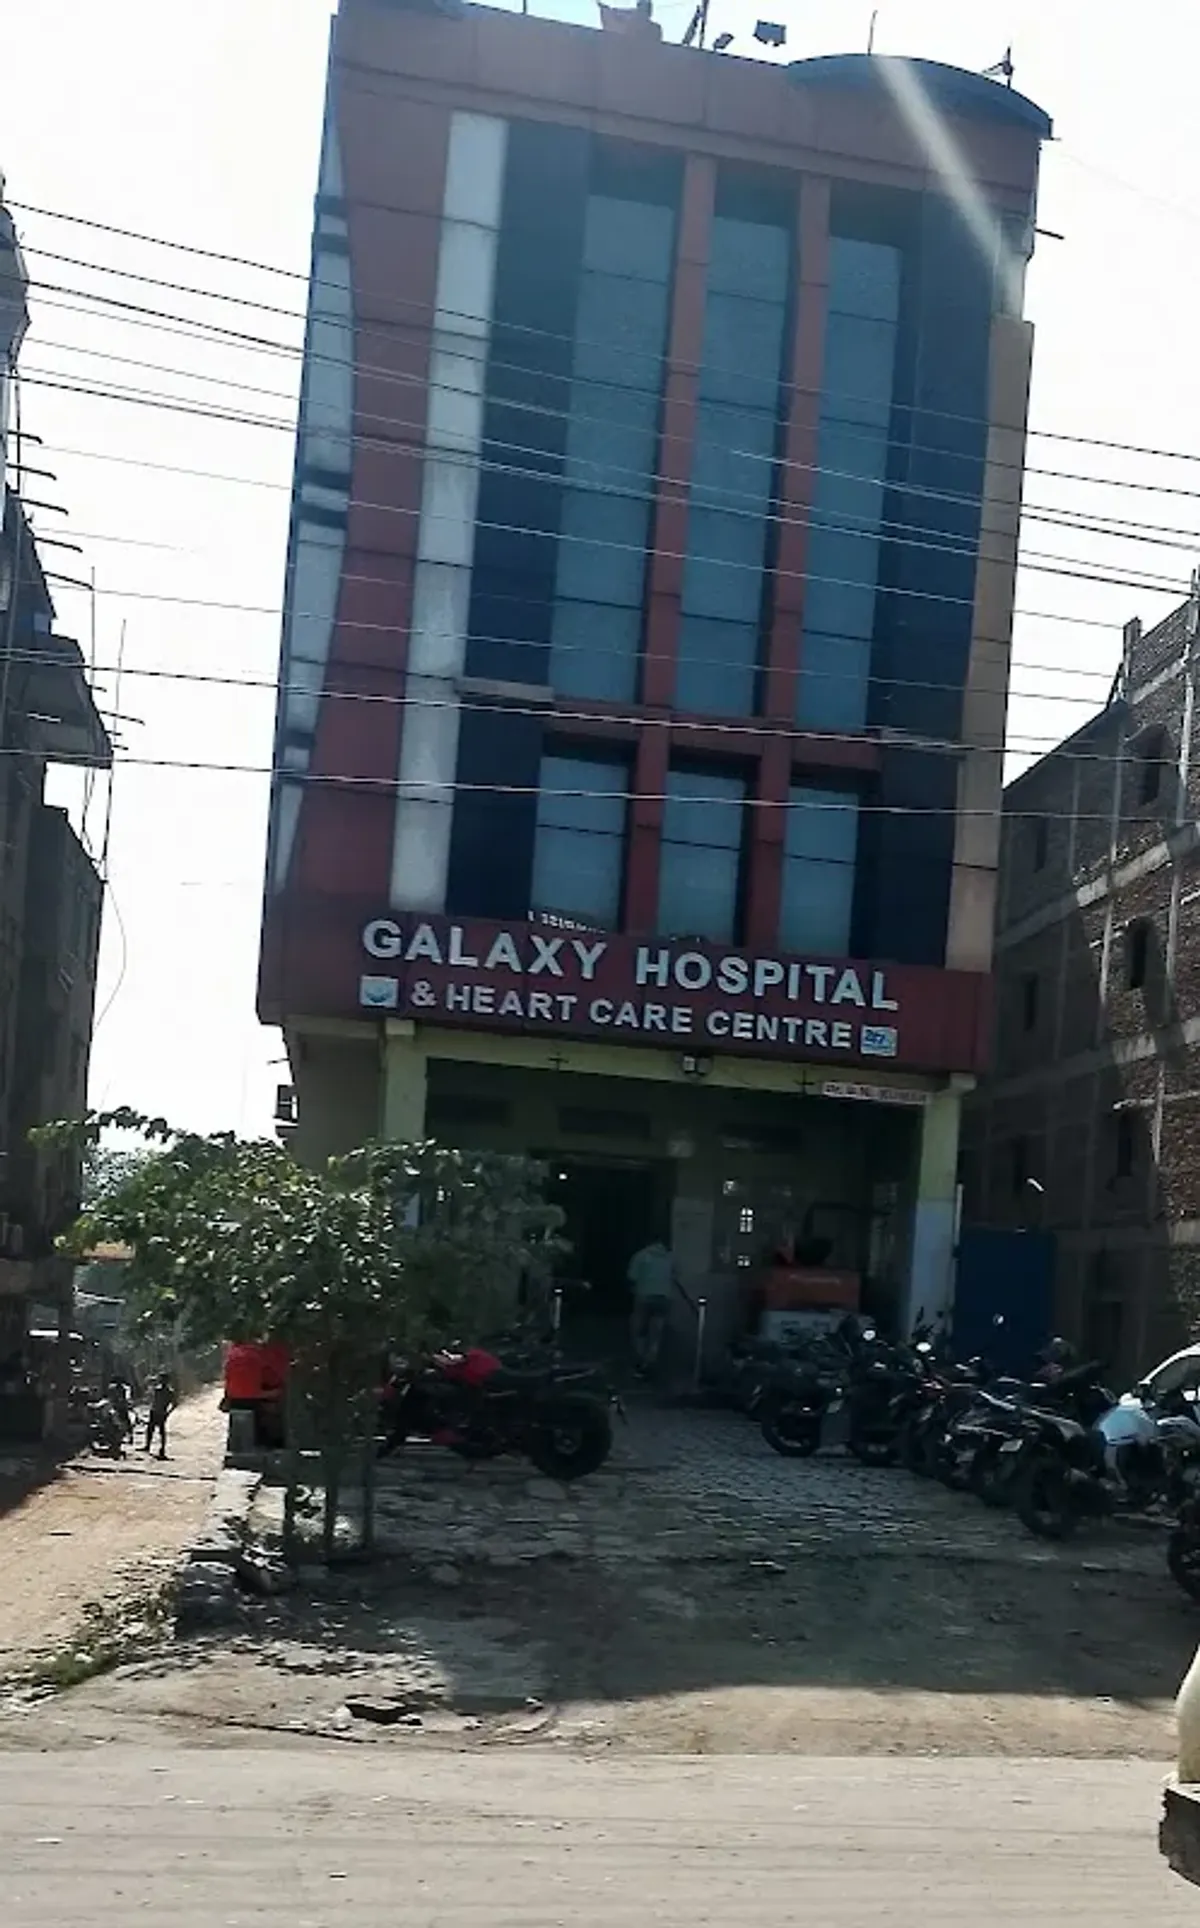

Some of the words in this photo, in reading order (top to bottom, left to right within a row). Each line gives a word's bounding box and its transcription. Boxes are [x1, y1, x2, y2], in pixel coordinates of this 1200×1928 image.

[362, 919, 608, 980] GALAXY
[635, 946, 898, 1012] HOSPITAL
[410, 980, 437, 1007] &
[445, 982, 578, 1021] HEART
[589, 999, 693, 1034] CARE
[706, 1010, 852, 1049] CENTRE
